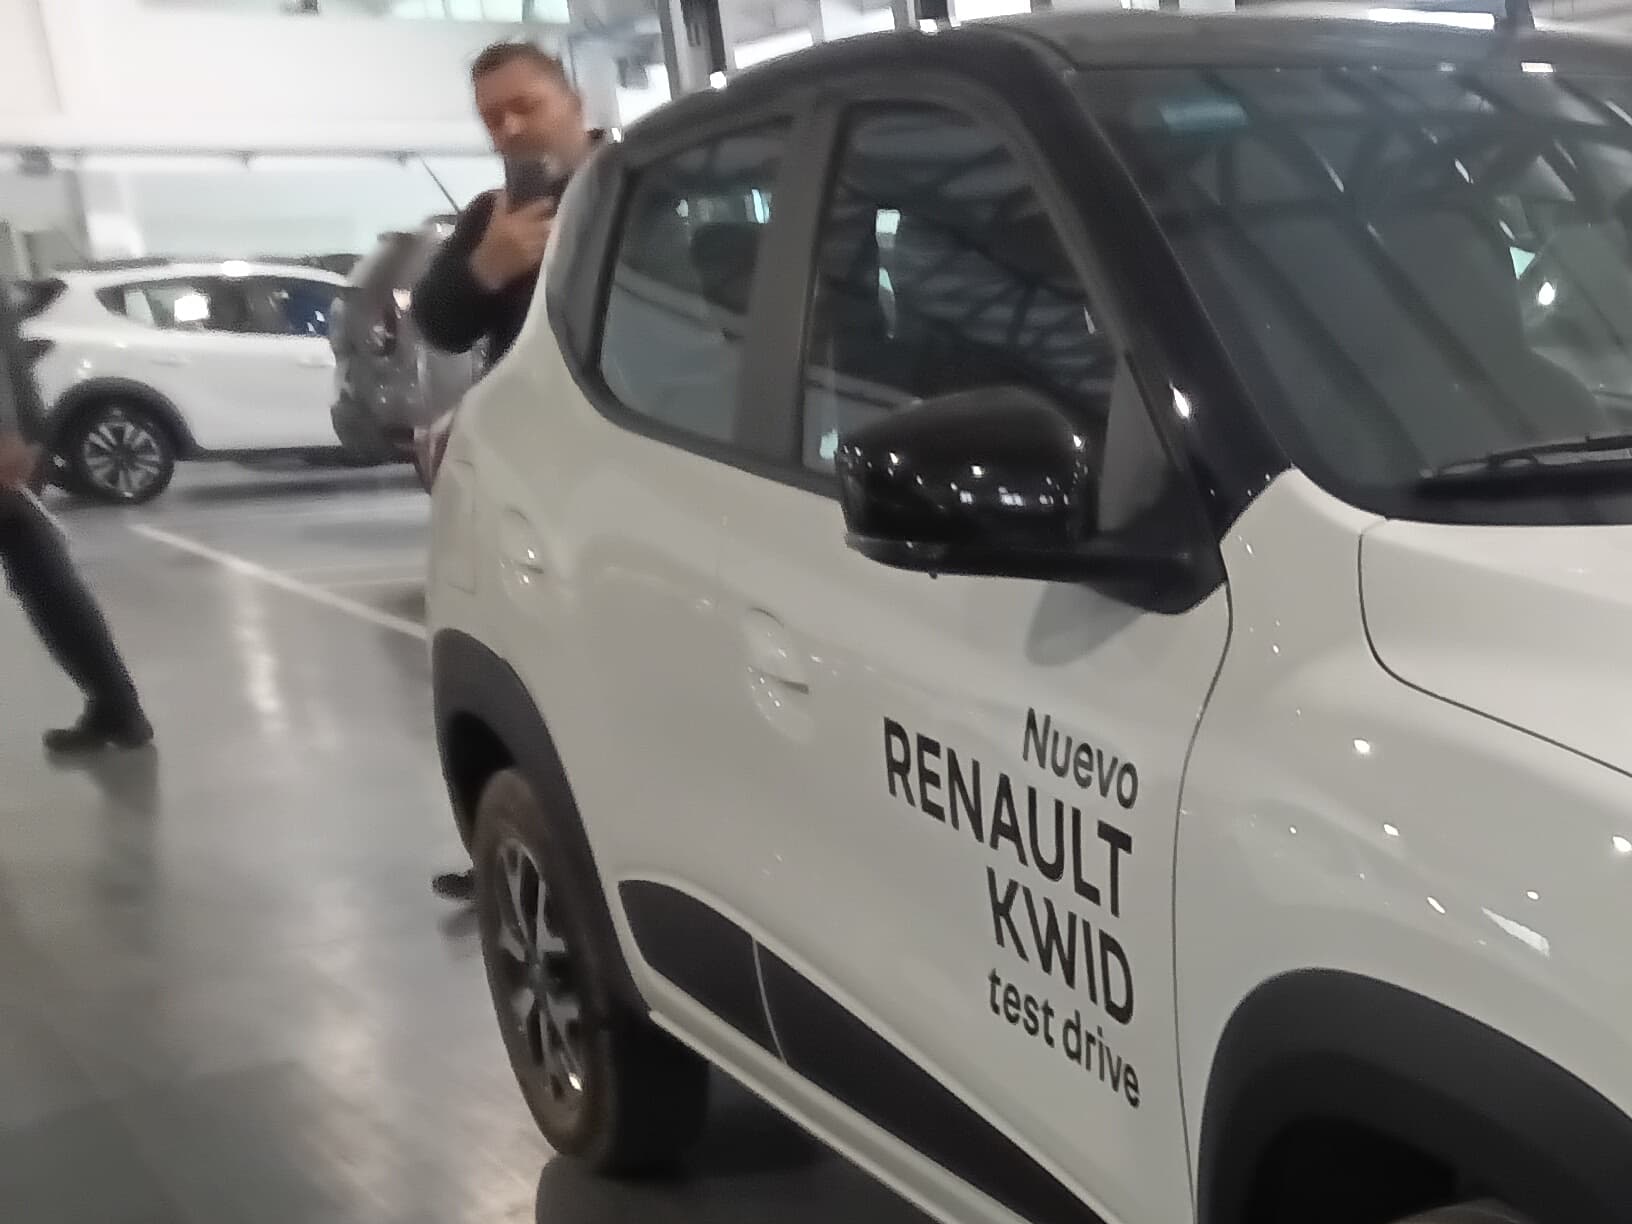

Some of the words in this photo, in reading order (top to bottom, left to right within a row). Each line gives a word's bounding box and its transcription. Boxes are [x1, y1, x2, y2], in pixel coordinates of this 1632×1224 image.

[883, 716, 1132, 918] RENAULT
[1022, 707, 1139, 809] Nuevo
[986, 865, 1133, 1025] KWID
[987, 967, 1055, 1048] test
[1063, 1010, 1141, 1108] drive
